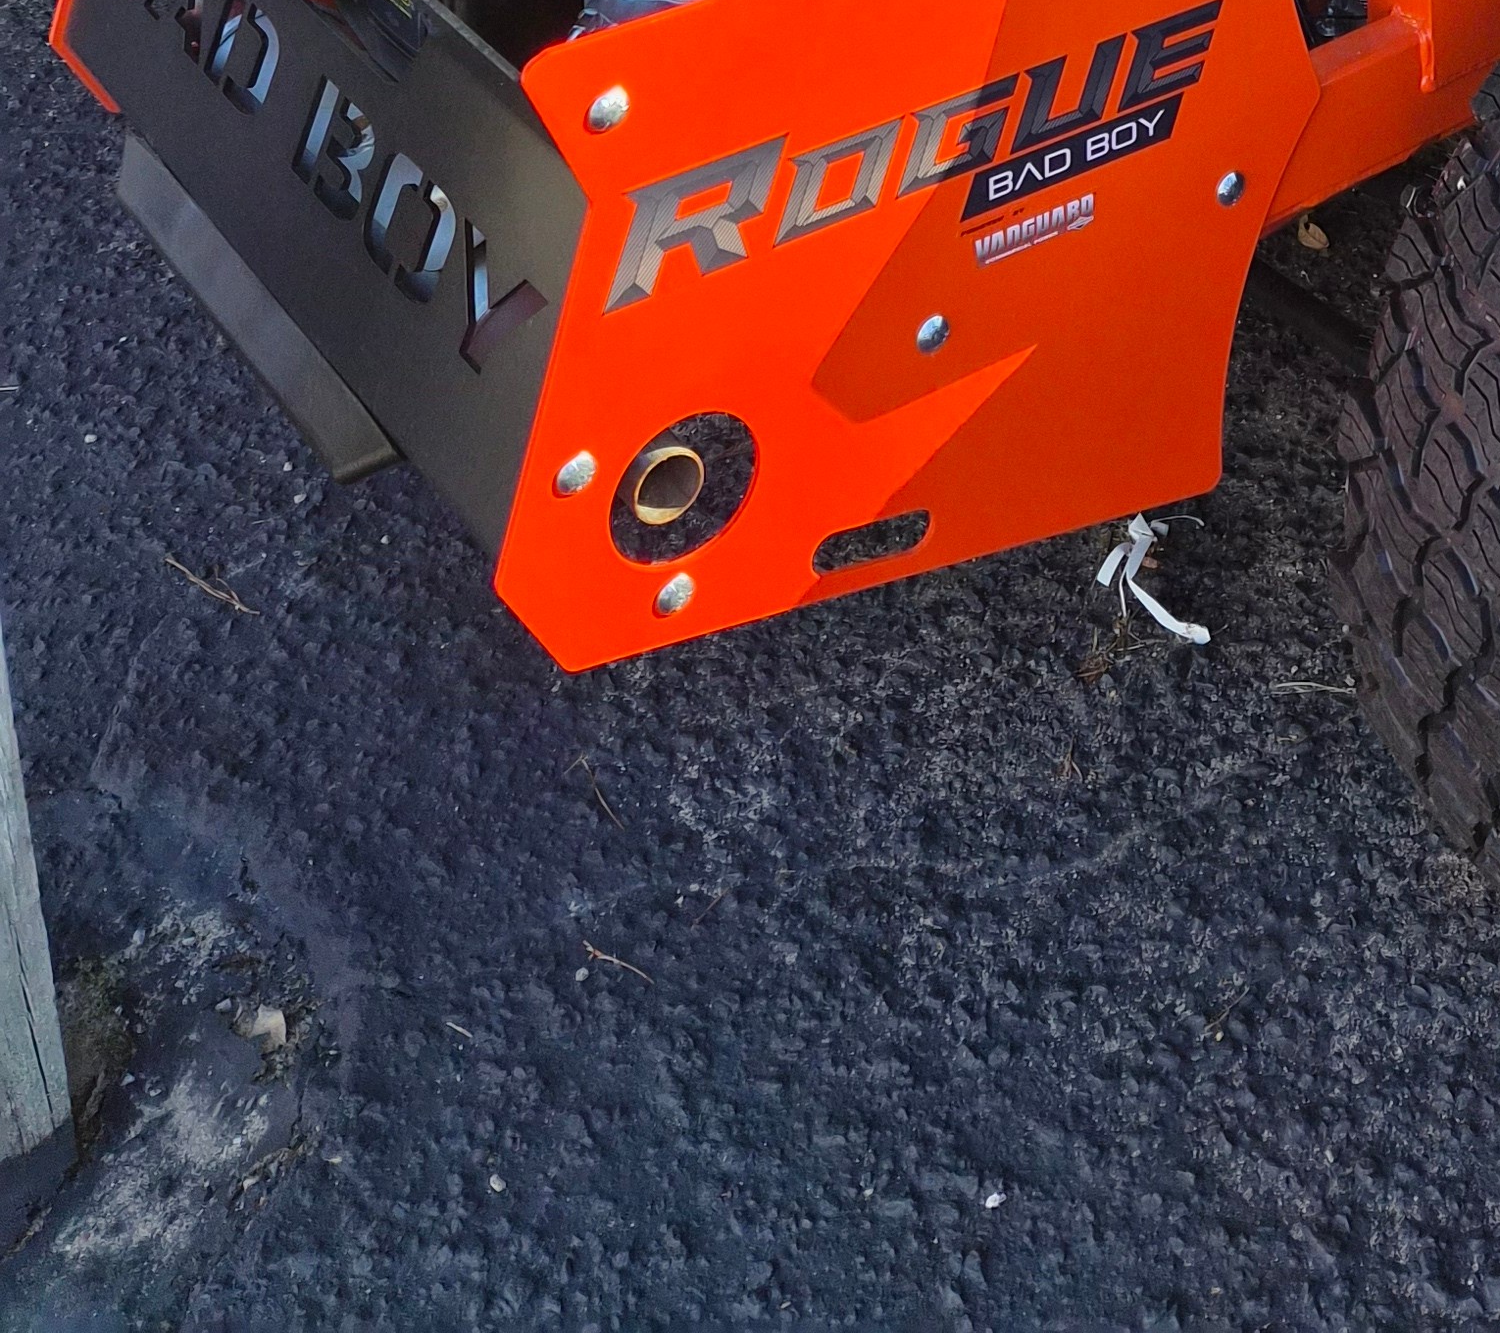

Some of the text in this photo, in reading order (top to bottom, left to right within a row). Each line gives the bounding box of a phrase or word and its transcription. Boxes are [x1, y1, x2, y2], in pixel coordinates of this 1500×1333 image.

[988, 108, 1166, 202] BAD BOY
[291, 73, 549, 376] BOY
[974, 192, 1095, 262] VANGUARD
